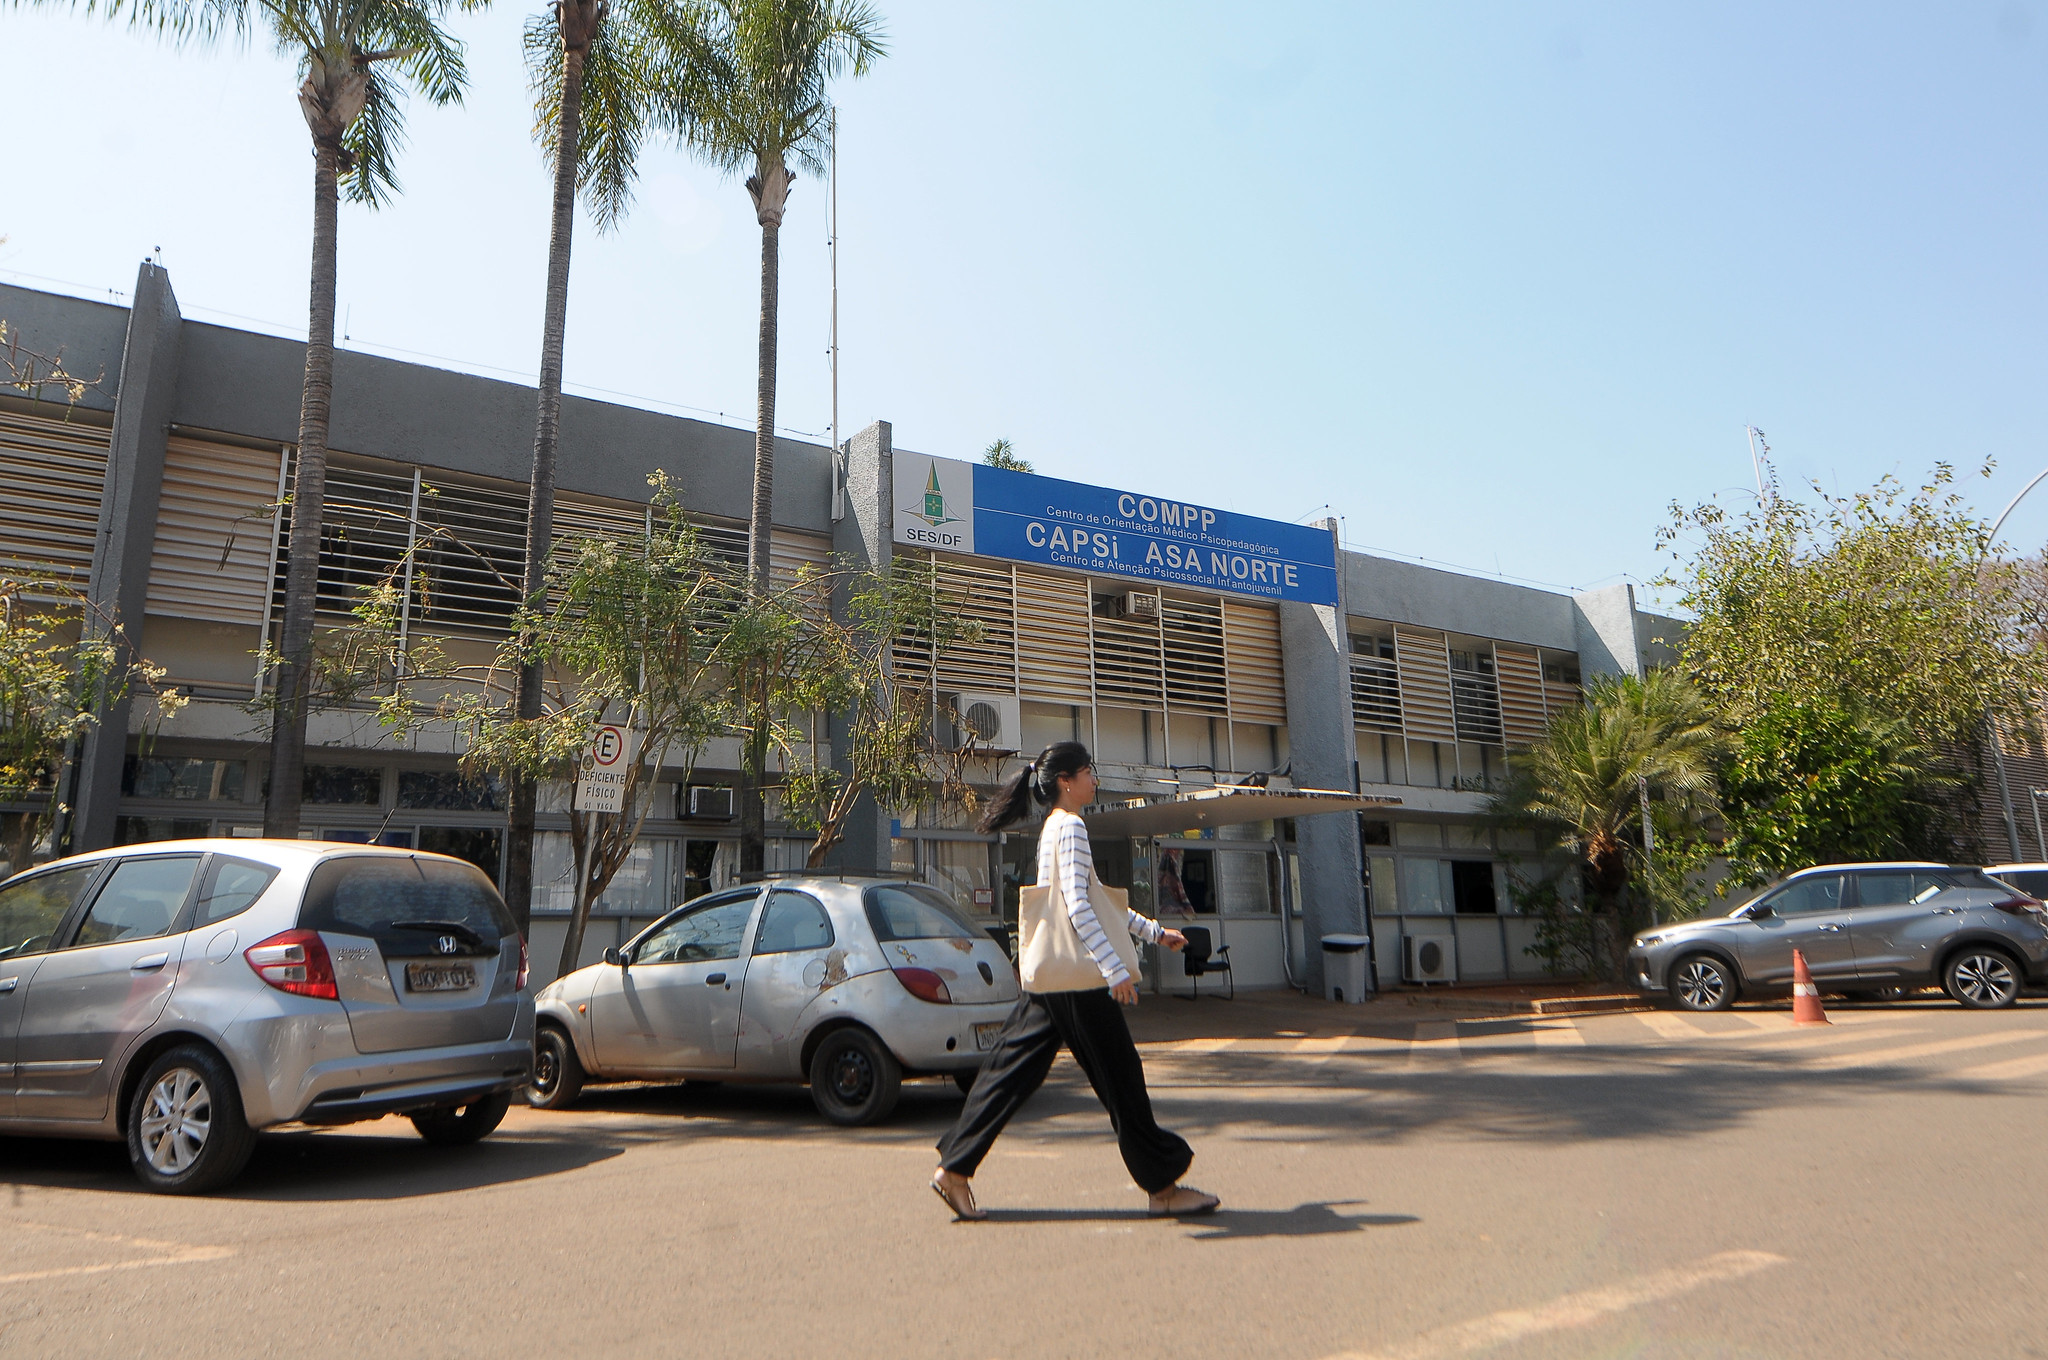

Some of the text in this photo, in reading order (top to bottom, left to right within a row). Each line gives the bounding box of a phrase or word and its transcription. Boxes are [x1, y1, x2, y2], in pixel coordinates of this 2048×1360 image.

[1117, 493, 1217, 532] COMPP
[906, 528, 962, 547] SES/DF
[1046, 505, 1280, 556] Centro de Orientação Médico Psicopedagógica
[1025, 521, 1300, 588] CAPSi ASA NORTE
[1050, 551, 1088, 566] Centro
[1091, 558, 1105, 569] de
[1107, 560, 1151, 576] Atenção
[1153, 564, 1215, 585] Psicossocial
[601, 734, 615, 757] E
[579, 770, 626, 785] DEFICIENTE
[585, 783, 616, 799] FÍSICO
